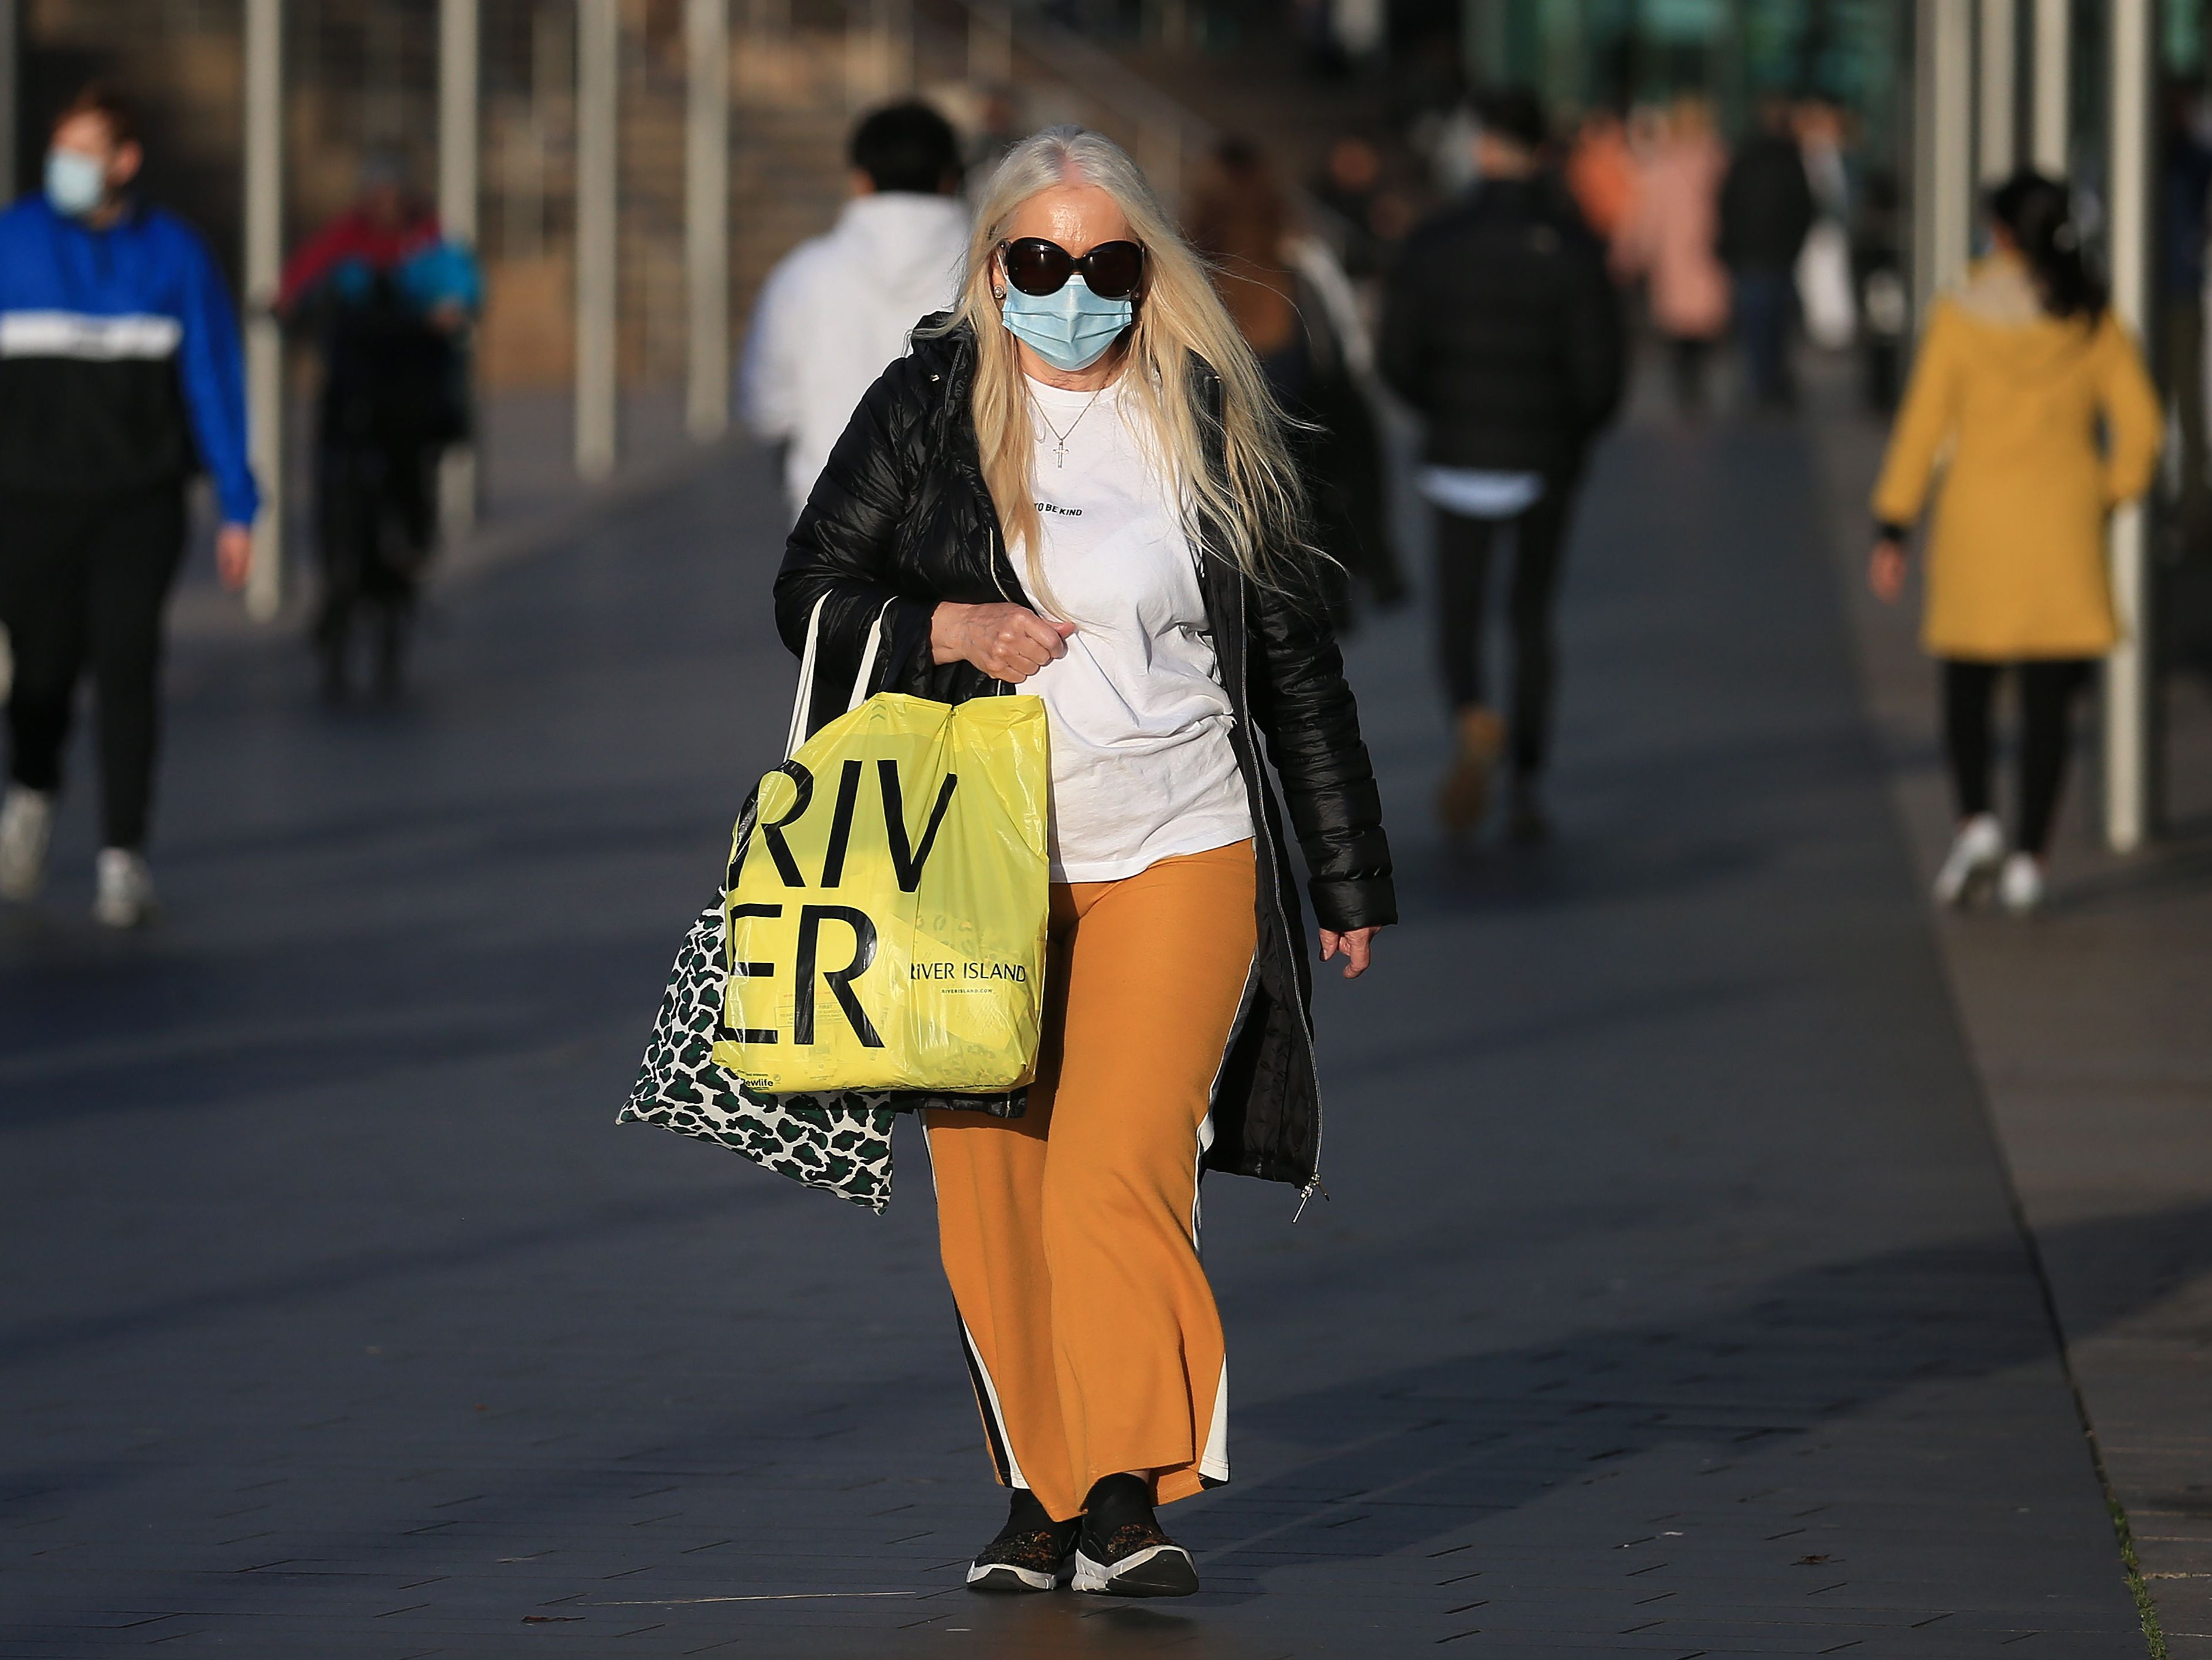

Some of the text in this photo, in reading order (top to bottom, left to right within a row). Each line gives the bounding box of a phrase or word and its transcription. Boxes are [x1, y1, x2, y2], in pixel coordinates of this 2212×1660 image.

[1046, 504, 1059, 513] BE
[1059, 508, 1083, 516] KIND
[729, 760, 958, 893] RIV
[713, 903, 886, 1048] ER
[910, 962, 1026, 982] RIVER ISLAND
